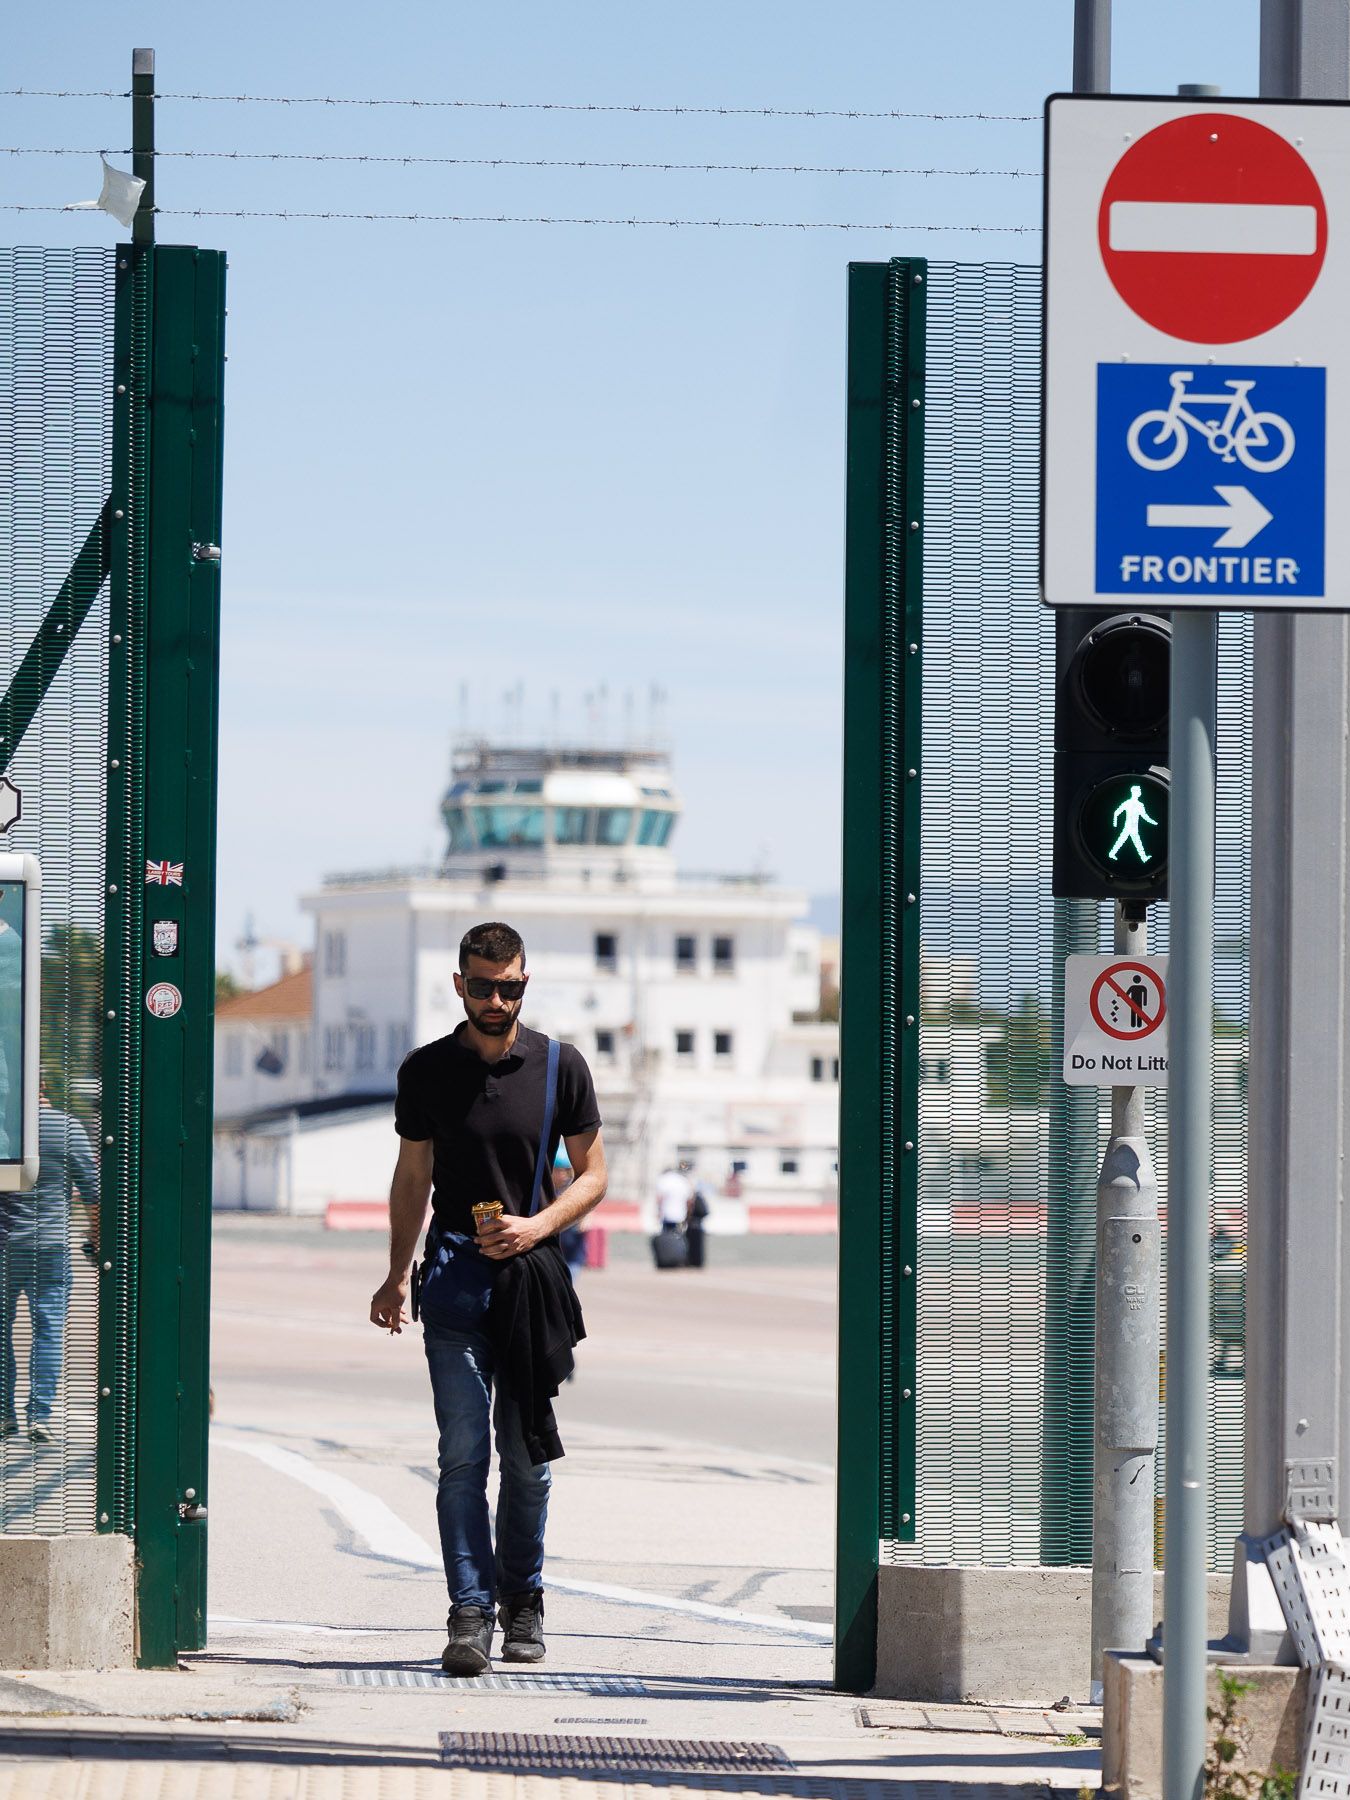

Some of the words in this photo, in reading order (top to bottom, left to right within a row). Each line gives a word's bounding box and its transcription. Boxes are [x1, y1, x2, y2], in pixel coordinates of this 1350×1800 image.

[1121, 556, 1297, 584] FRONTIER
[1072, 1055, 1096, 1070] Do
[1102, 1055, 1132, 1070] Not
